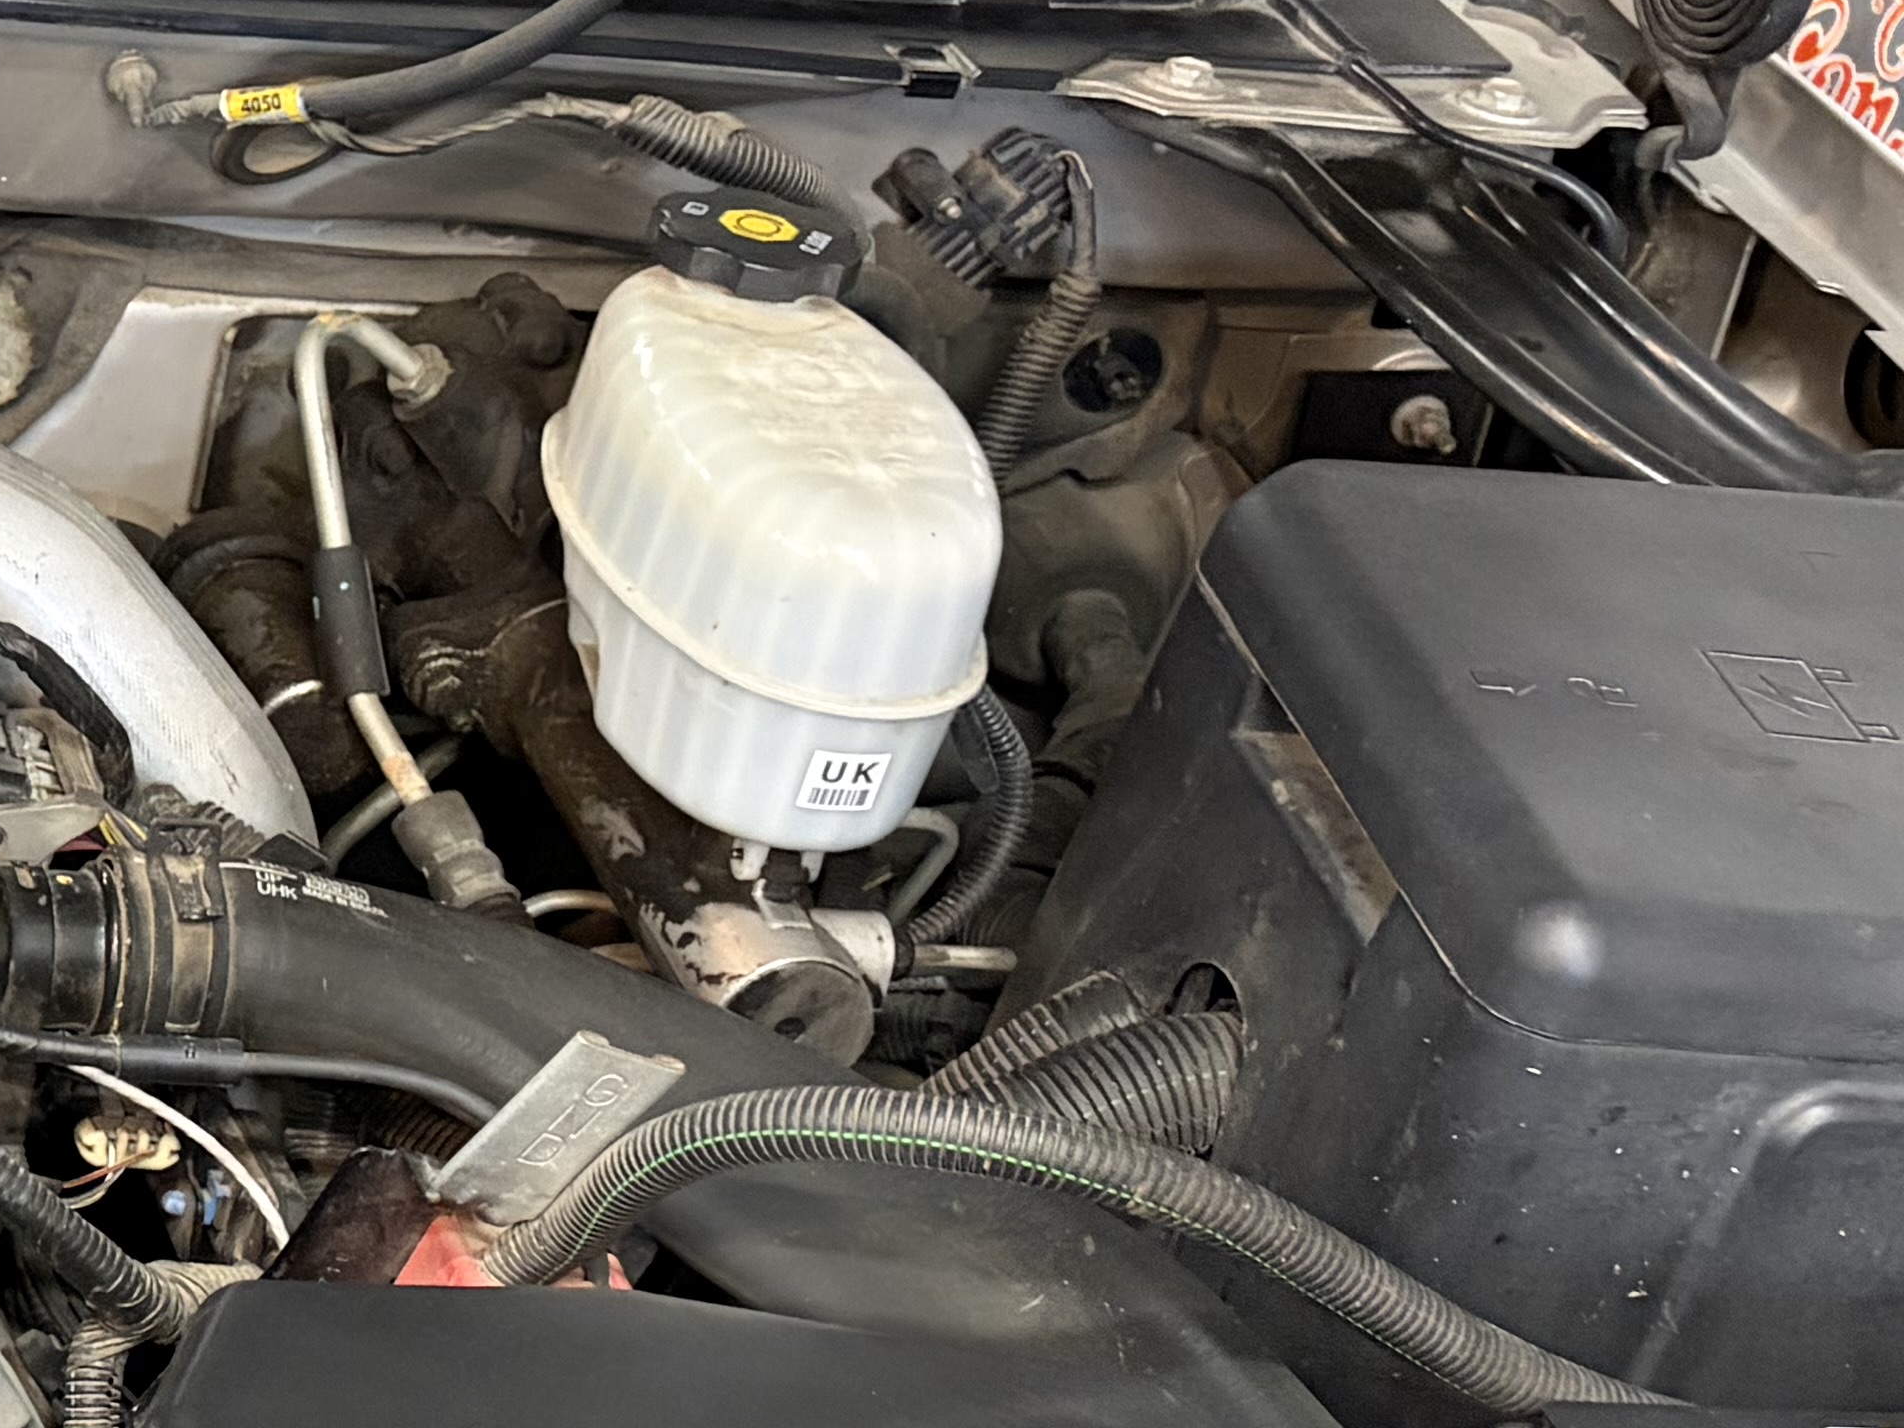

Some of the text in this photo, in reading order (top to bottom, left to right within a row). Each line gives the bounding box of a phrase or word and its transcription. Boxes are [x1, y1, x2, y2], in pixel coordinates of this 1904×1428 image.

[241, 93, 281, 114] 4050
[821, 760, 880, 784] UK
[257, 882, 298, 900] UHK
